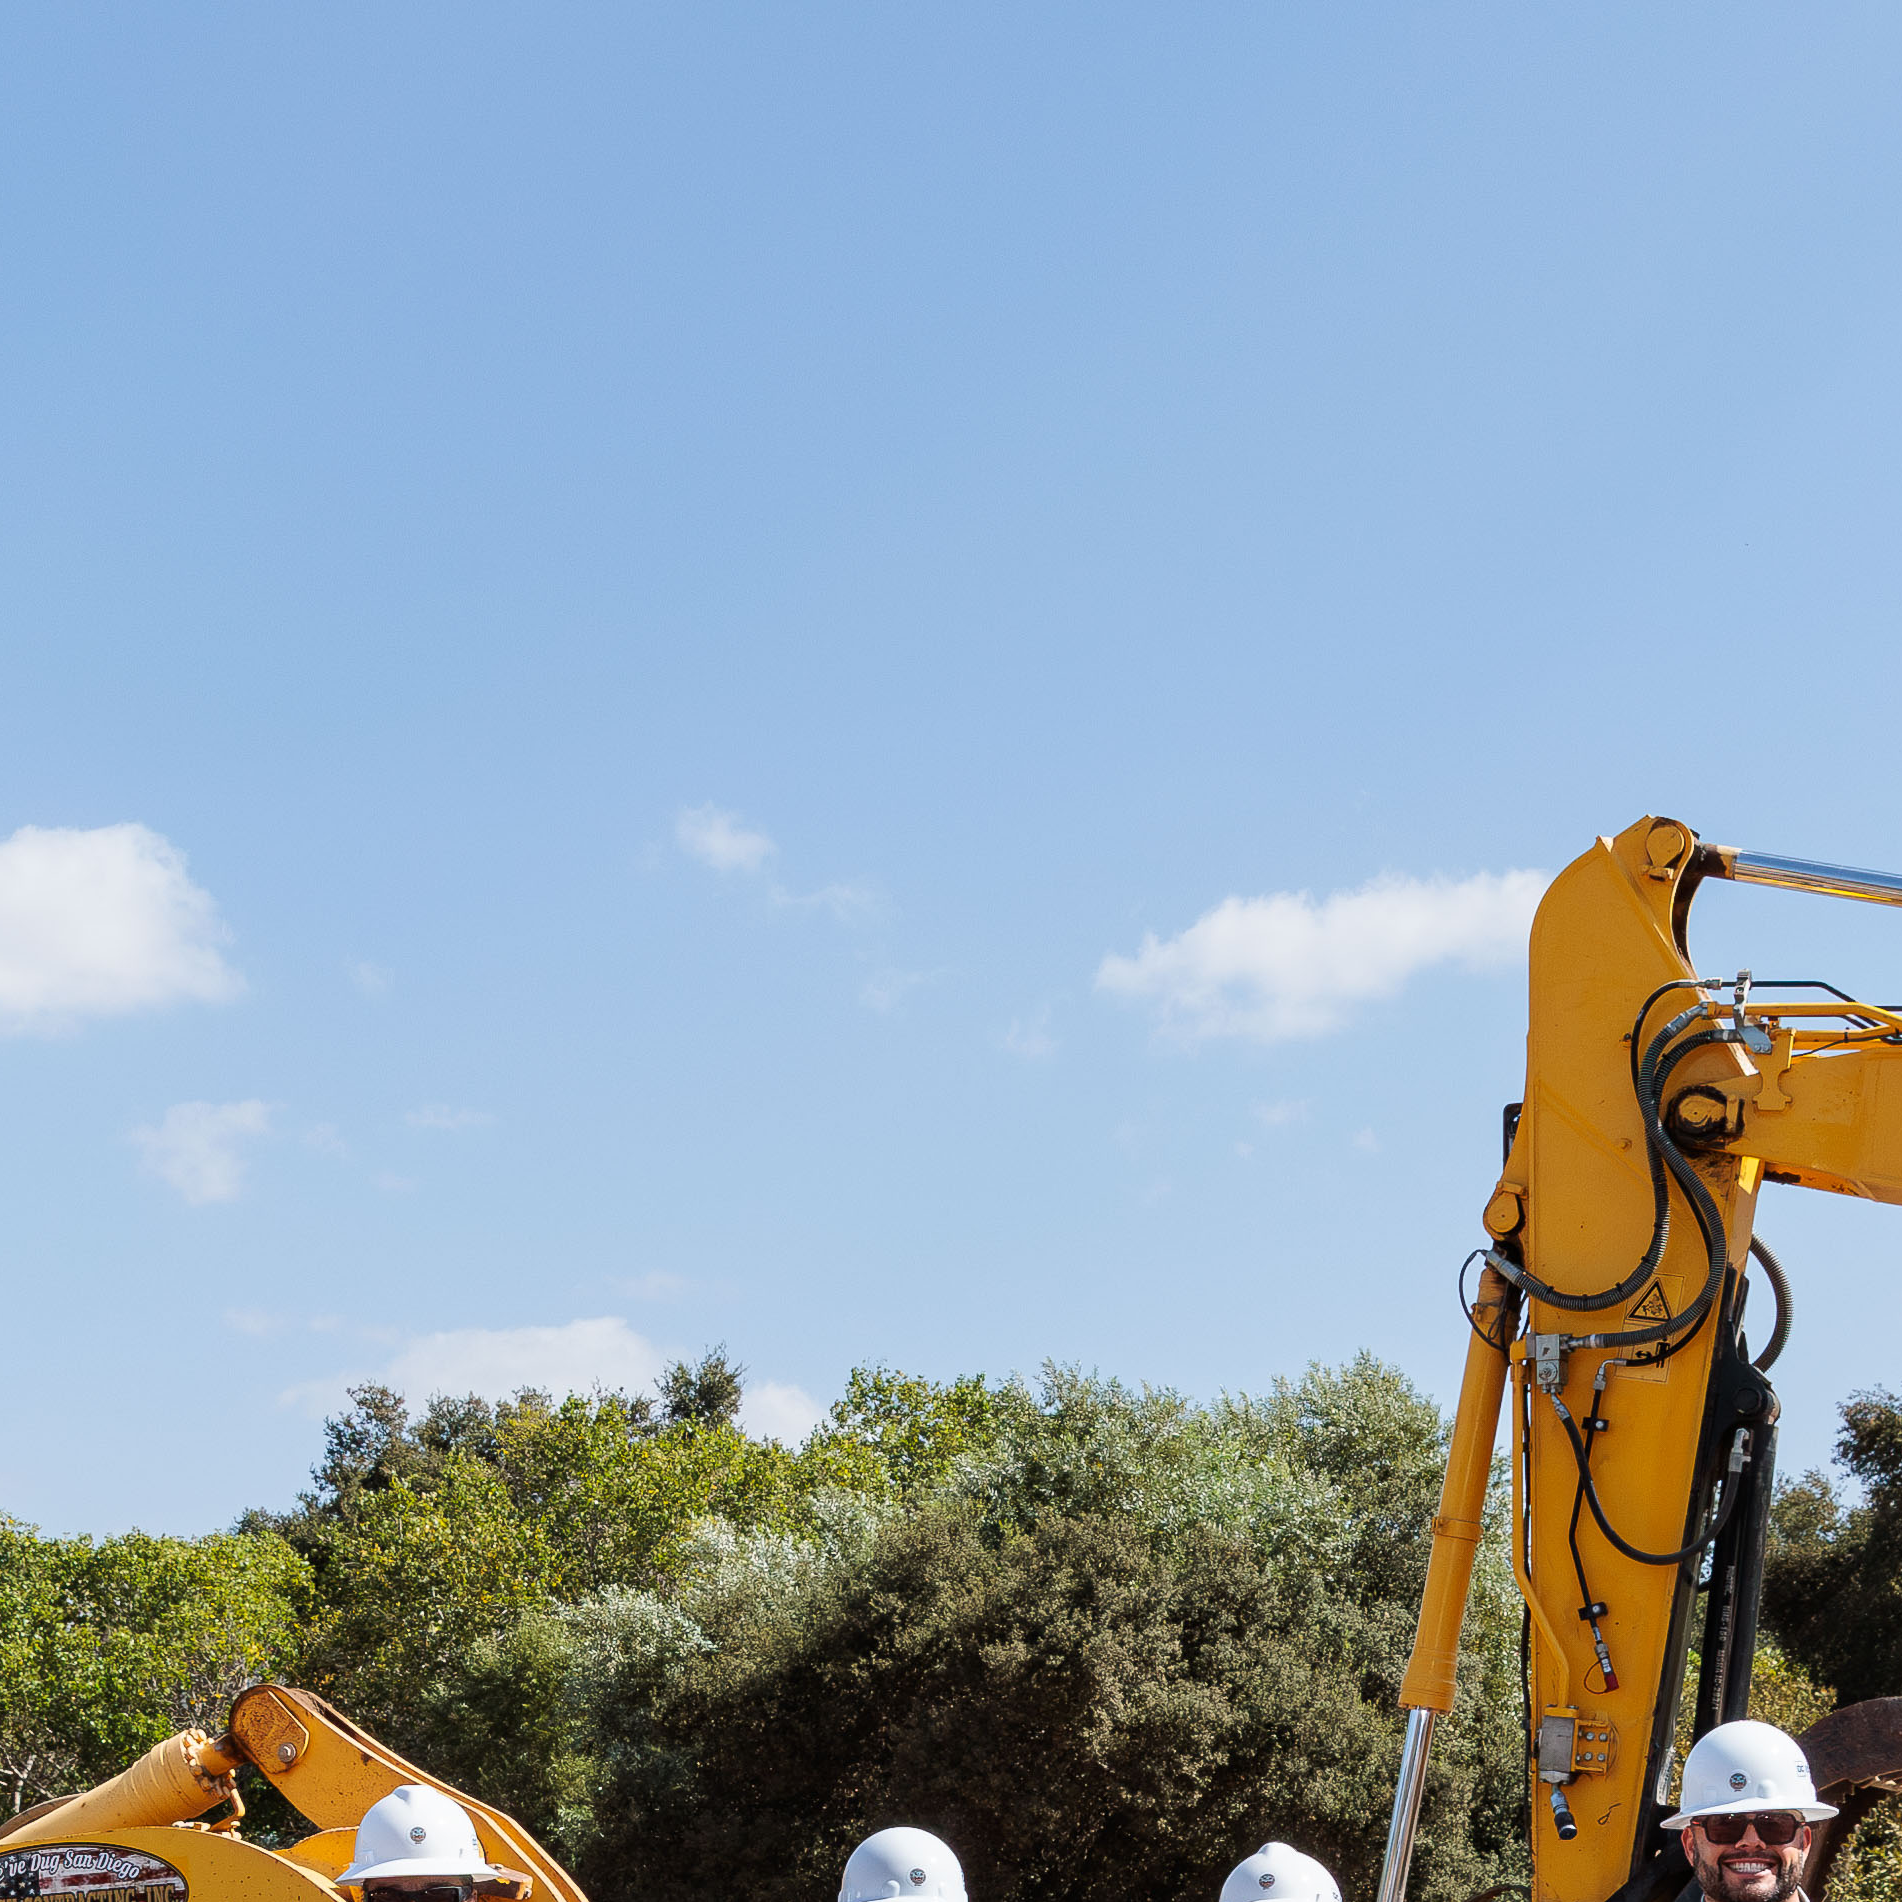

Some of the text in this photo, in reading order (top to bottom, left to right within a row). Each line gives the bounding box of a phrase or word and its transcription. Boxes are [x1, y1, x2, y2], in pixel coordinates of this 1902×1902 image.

[31, 1853, 59, 1875] Dug
[64, 1850, 93, 1869] San
[96, 1853, 140, 1879] Diego
